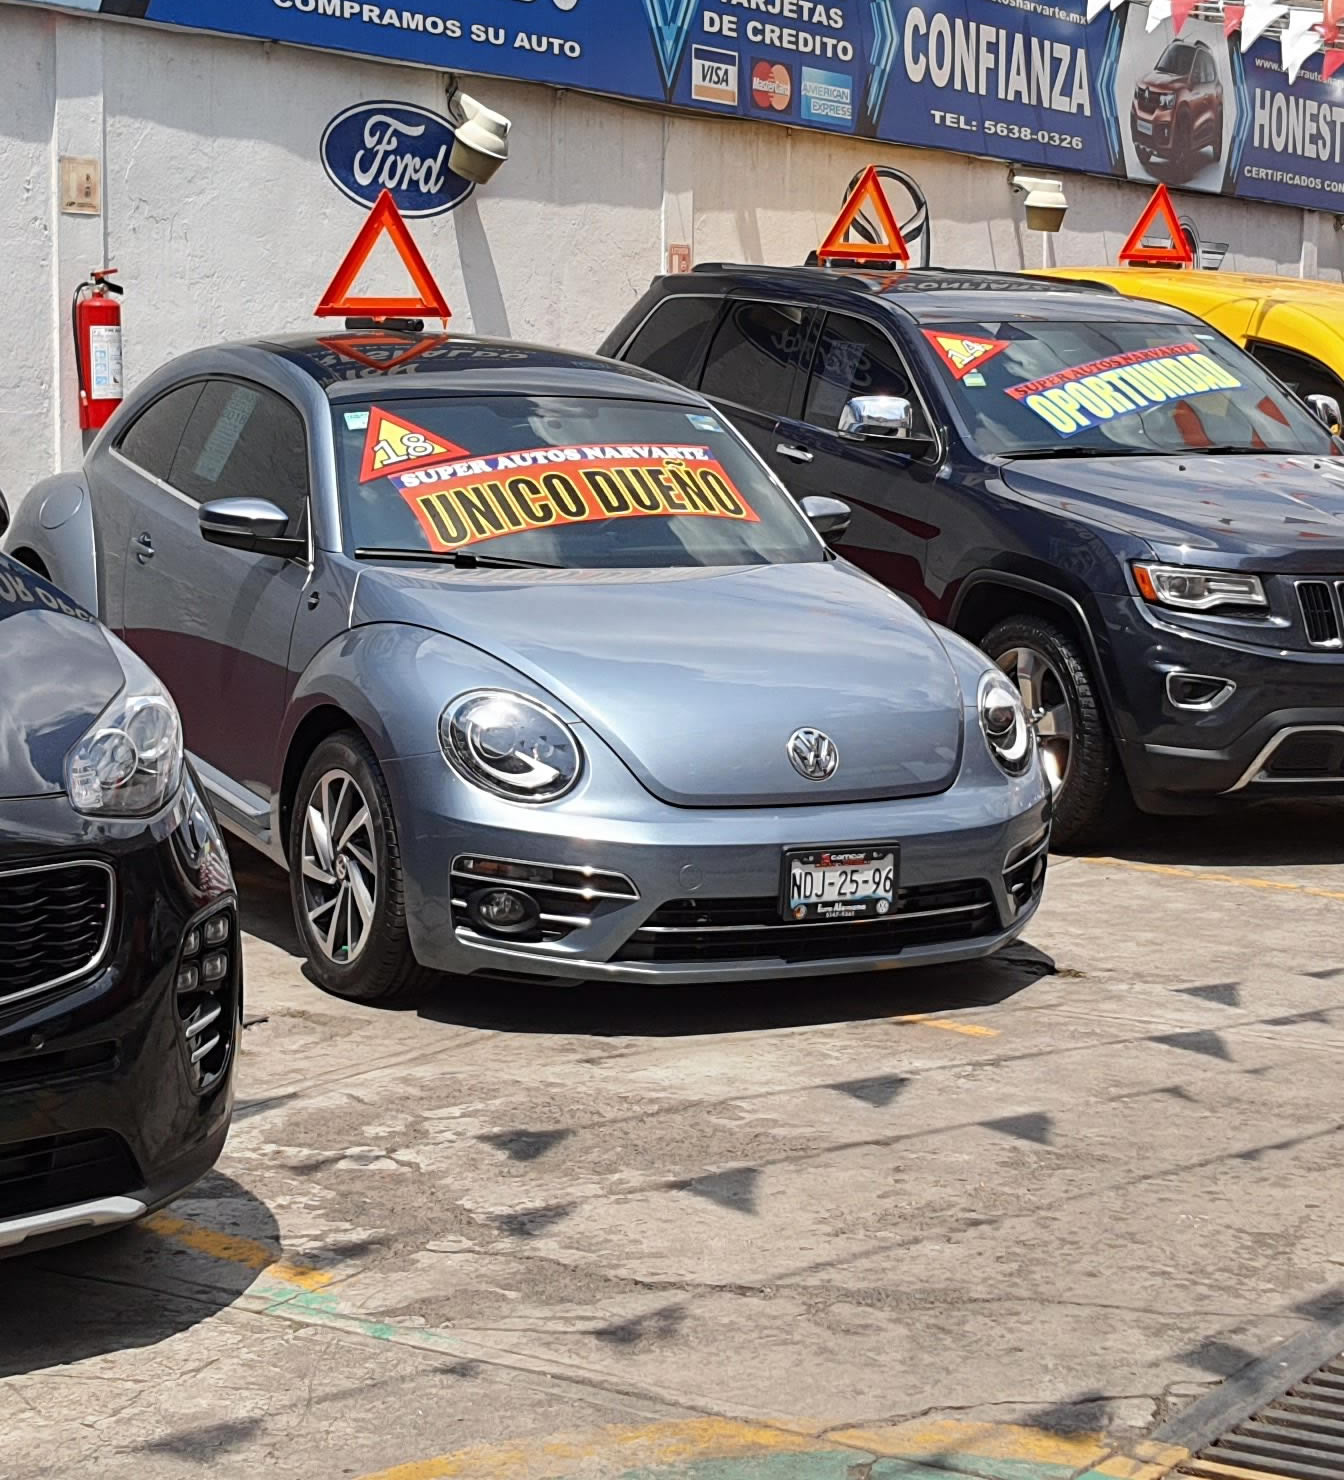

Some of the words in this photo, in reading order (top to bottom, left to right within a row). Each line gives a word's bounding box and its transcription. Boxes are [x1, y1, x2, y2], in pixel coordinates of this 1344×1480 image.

[720, 0, 844, 29] RJETAS
[470, 23, 505, 45] SU
[513, 31, 582, 58] AUTO
[703, 11, 738, 37] DE
[746, 21, 854, 62] CREDITO
[701, 63, 729, 87] VISA
[903, 6, 1091, 117] CONFIANZA
[802, 81, 849, 101] AMERICAN
[812, 101, 853, 117] EXPRESS
[930, 109, 977, 130] TEL:
[983, 120, 1083, 150] 5638-0326
[353, 114, 447, 194] Ford
[1244, 165, 1321, 189] CERTIFICADOS
[1014, 373, 1071, 396] SUPER
[1071, 357, 1121, 381] AUTOS
[1025, 353, 1242, 433] OPORTUNIDAD
[373, 433, 434, 466] 18
[400, 459, 494, 488] SUPER
[496, 447, 582, 471] AUTOS
[585, 446, 709, 461] NARVARTE
[416, 471, 589, 547] UNICO
[578, 458, 747, 517] DUEÑO
[791, 866, 894, 900] NDJ-25-96
